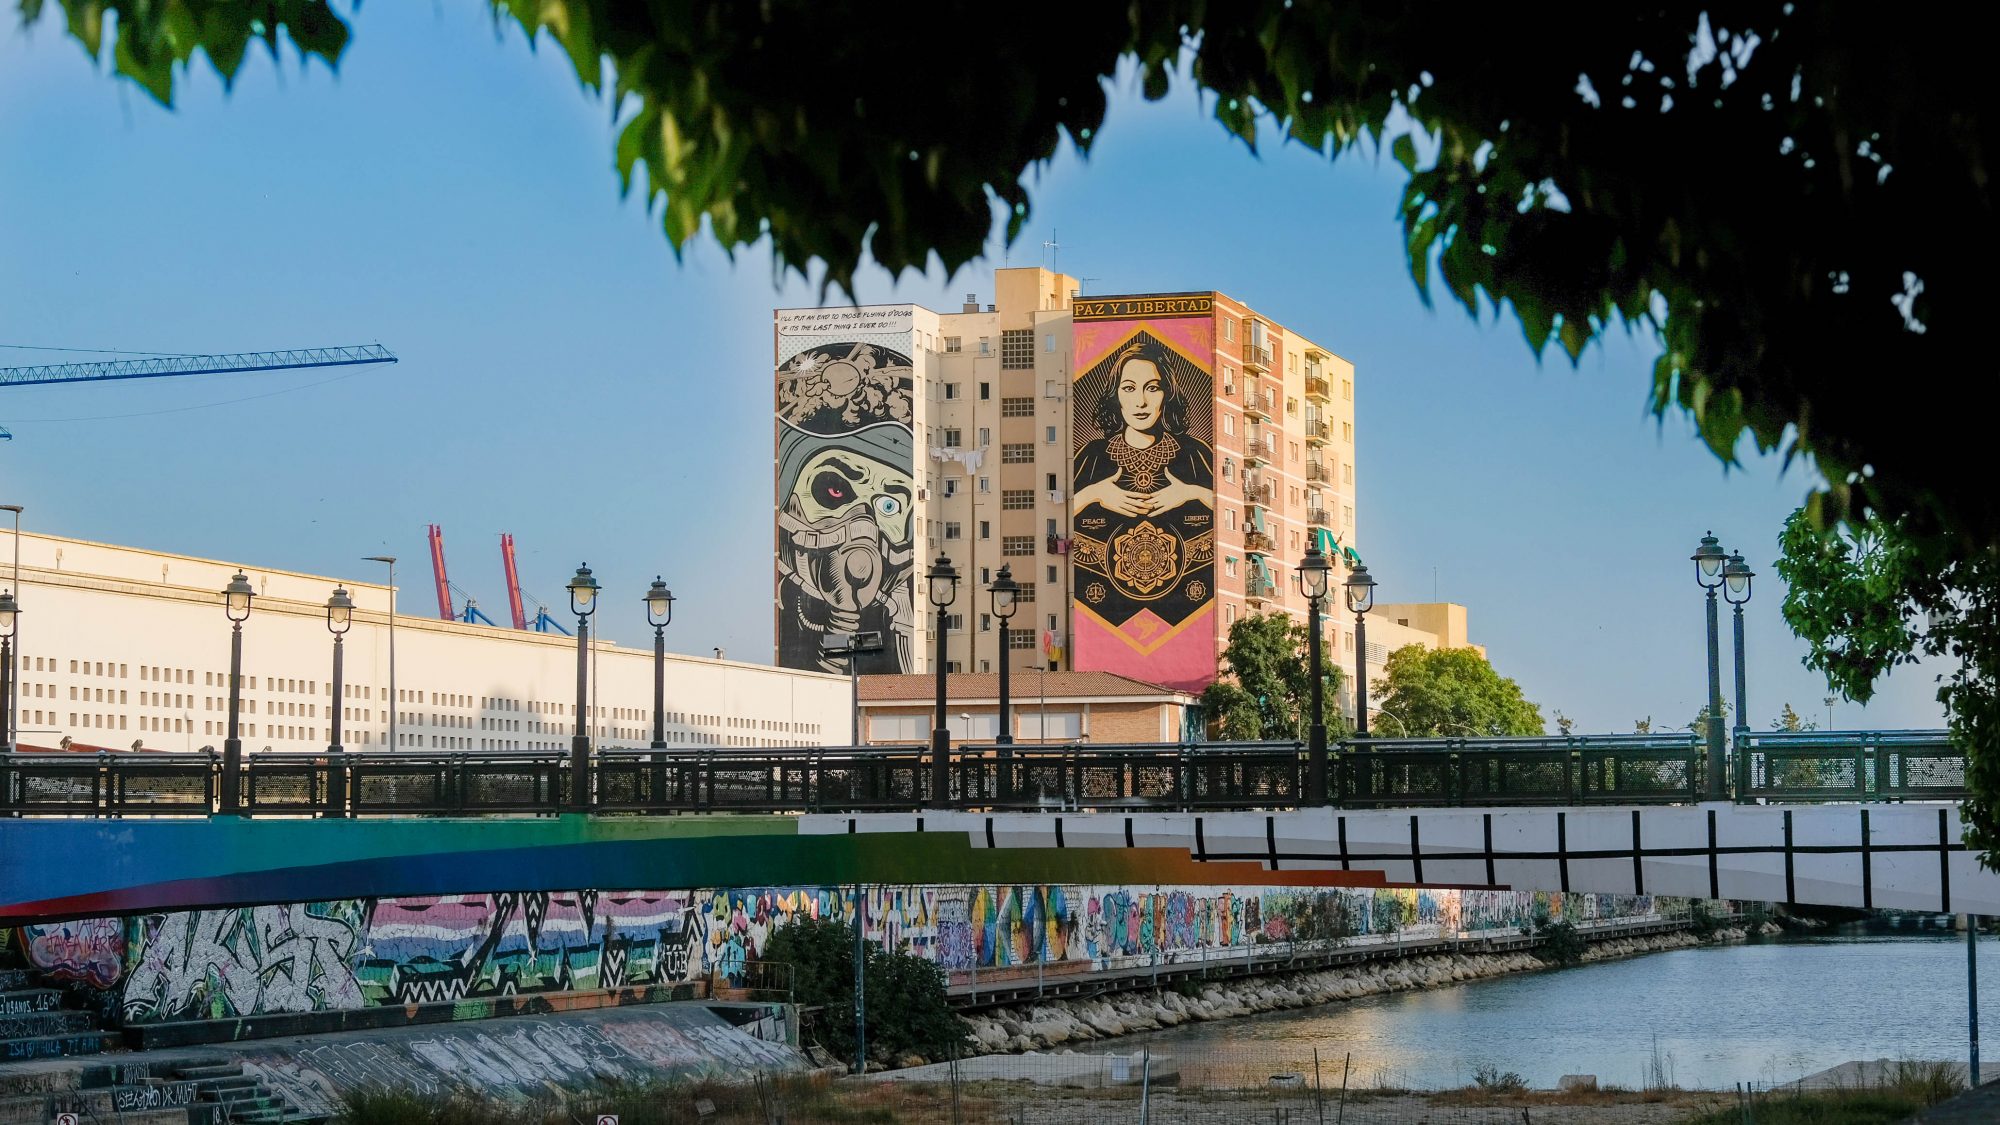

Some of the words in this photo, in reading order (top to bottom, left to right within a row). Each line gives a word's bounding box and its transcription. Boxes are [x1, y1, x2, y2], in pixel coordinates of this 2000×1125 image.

[1074, 303, 1104, 316] PAZ
[1110, 302, 1120, 314] Y
[1126, 299, 1211, 313] LIBERTAD
[813, 323, 832, 331] LAST
